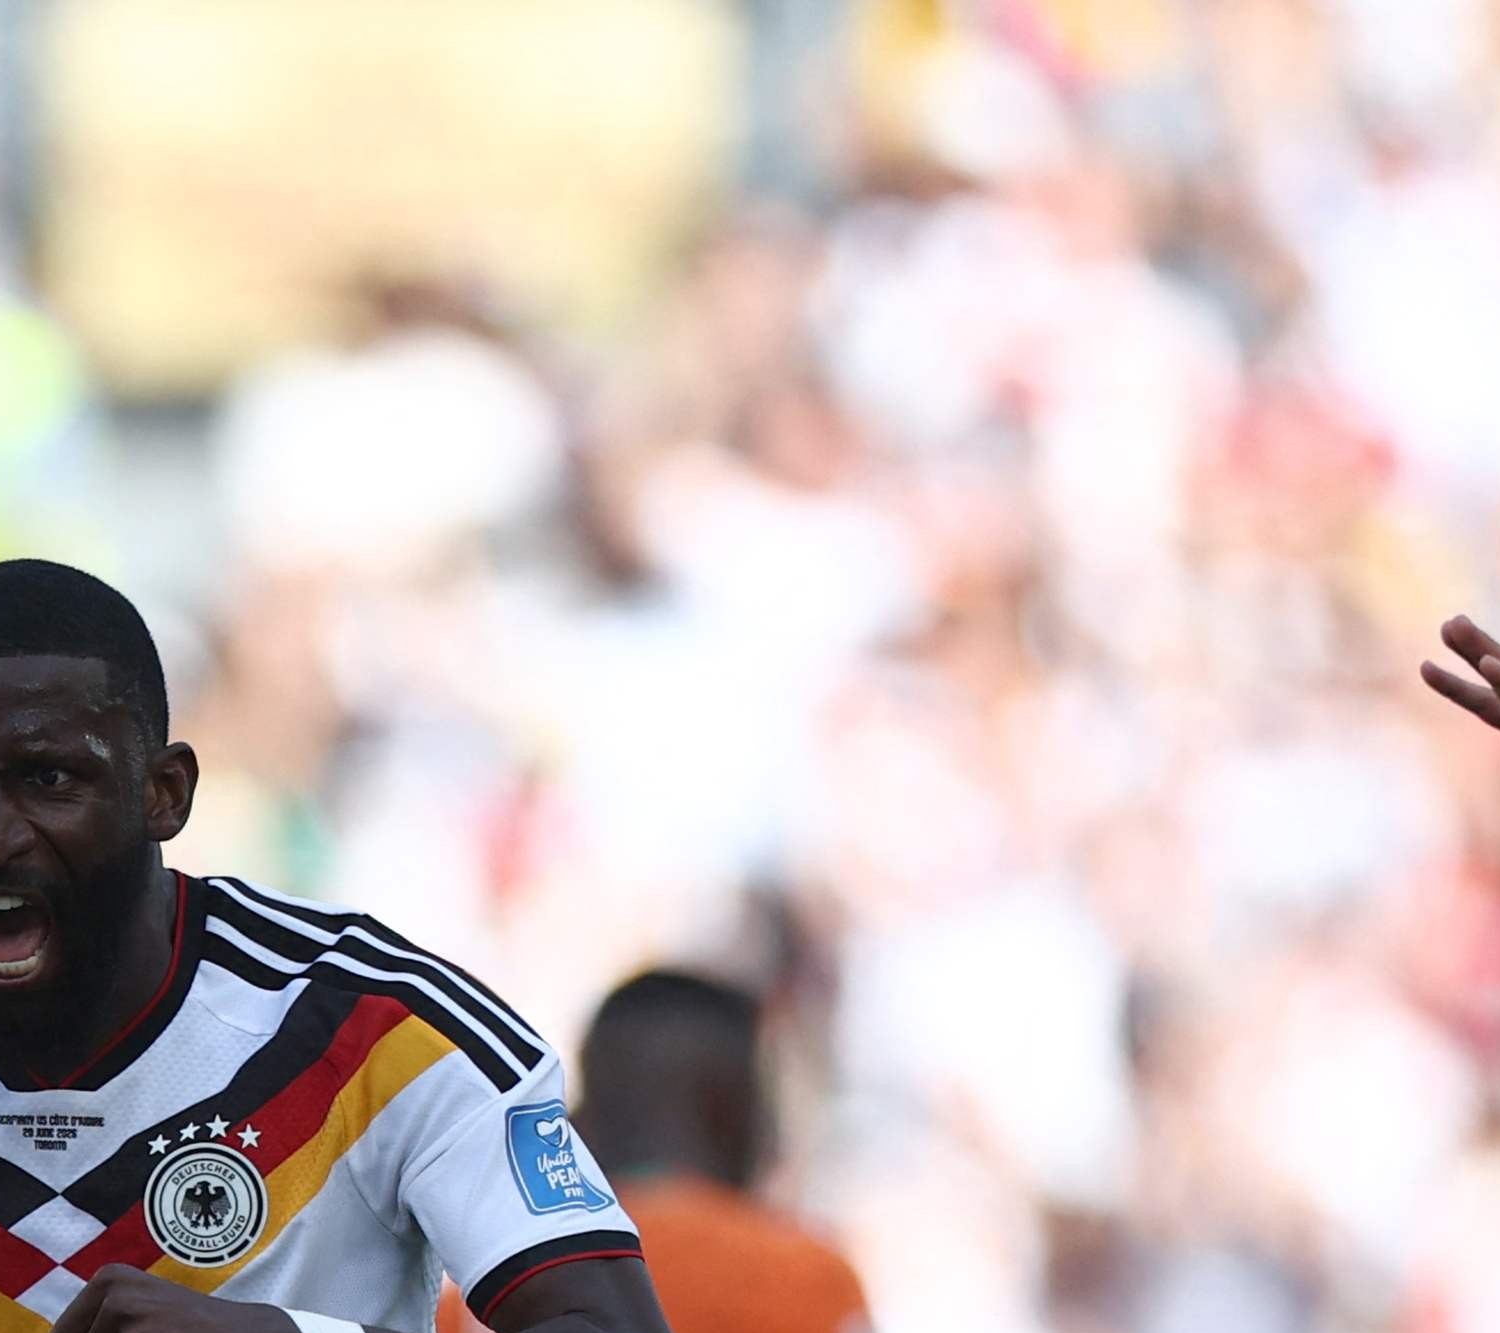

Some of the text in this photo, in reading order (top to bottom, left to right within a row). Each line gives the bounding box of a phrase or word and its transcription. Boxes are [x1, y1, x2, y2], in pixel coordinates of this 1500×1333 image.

[171, 1162, 236, 1186] DEUTSCHER
[546, 1167, 581, 1190] PEA
[167, 1215, 246, 1248] FUSSBALL-BUND
